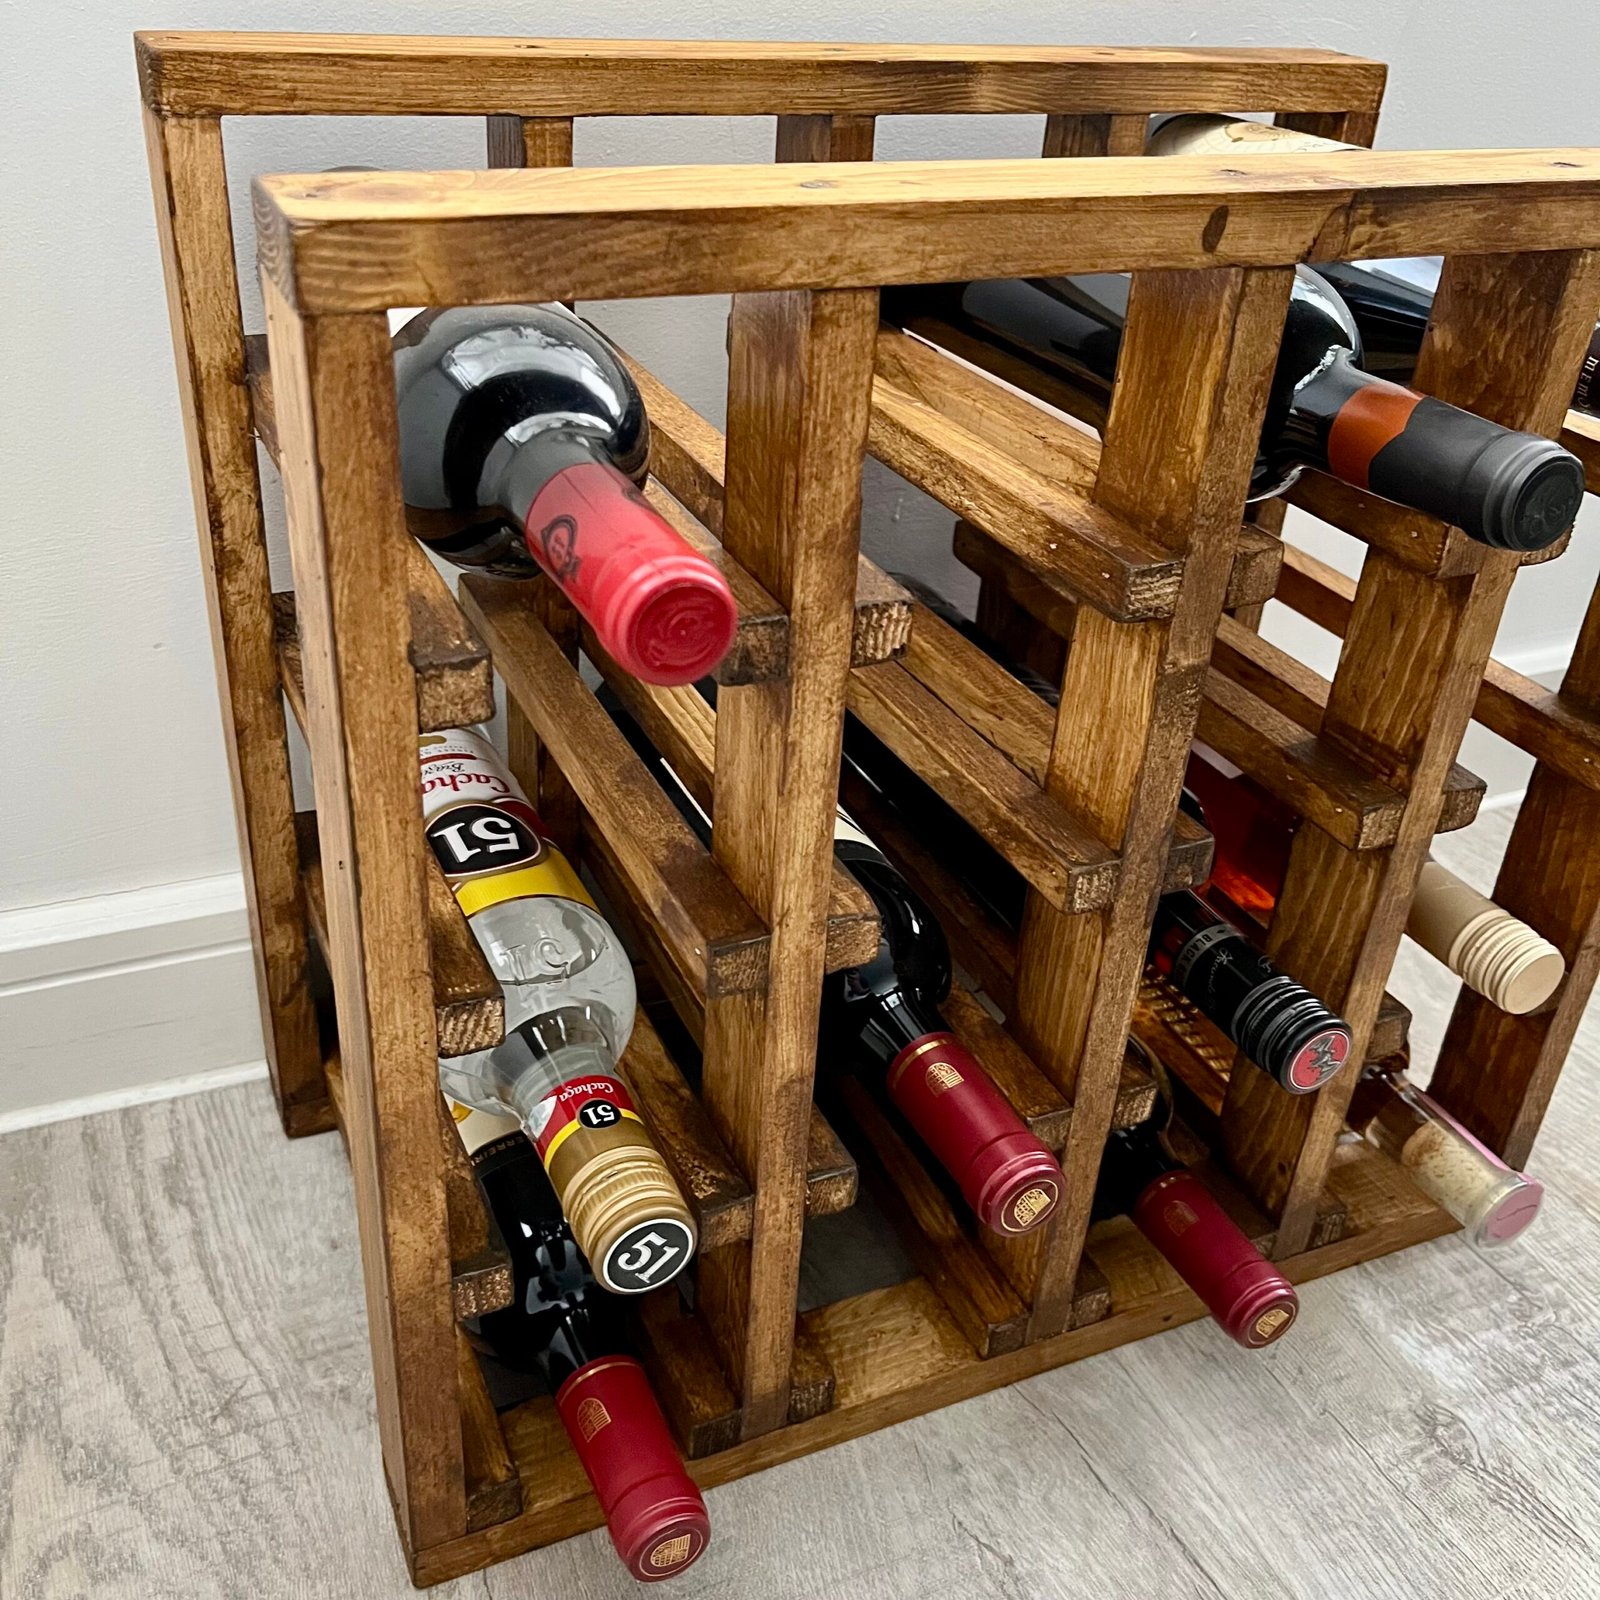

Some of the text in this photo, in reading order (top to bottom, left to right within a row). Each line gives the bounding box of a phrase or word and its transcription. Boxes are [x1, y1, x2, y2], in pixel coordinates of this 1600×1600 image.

[431, 817, 520, 862] 51
[559, 1082, 614, 1102] Cachaça
[583, 1104, 615, 1125] 51
[617, 1231, 680, 1284] 51
